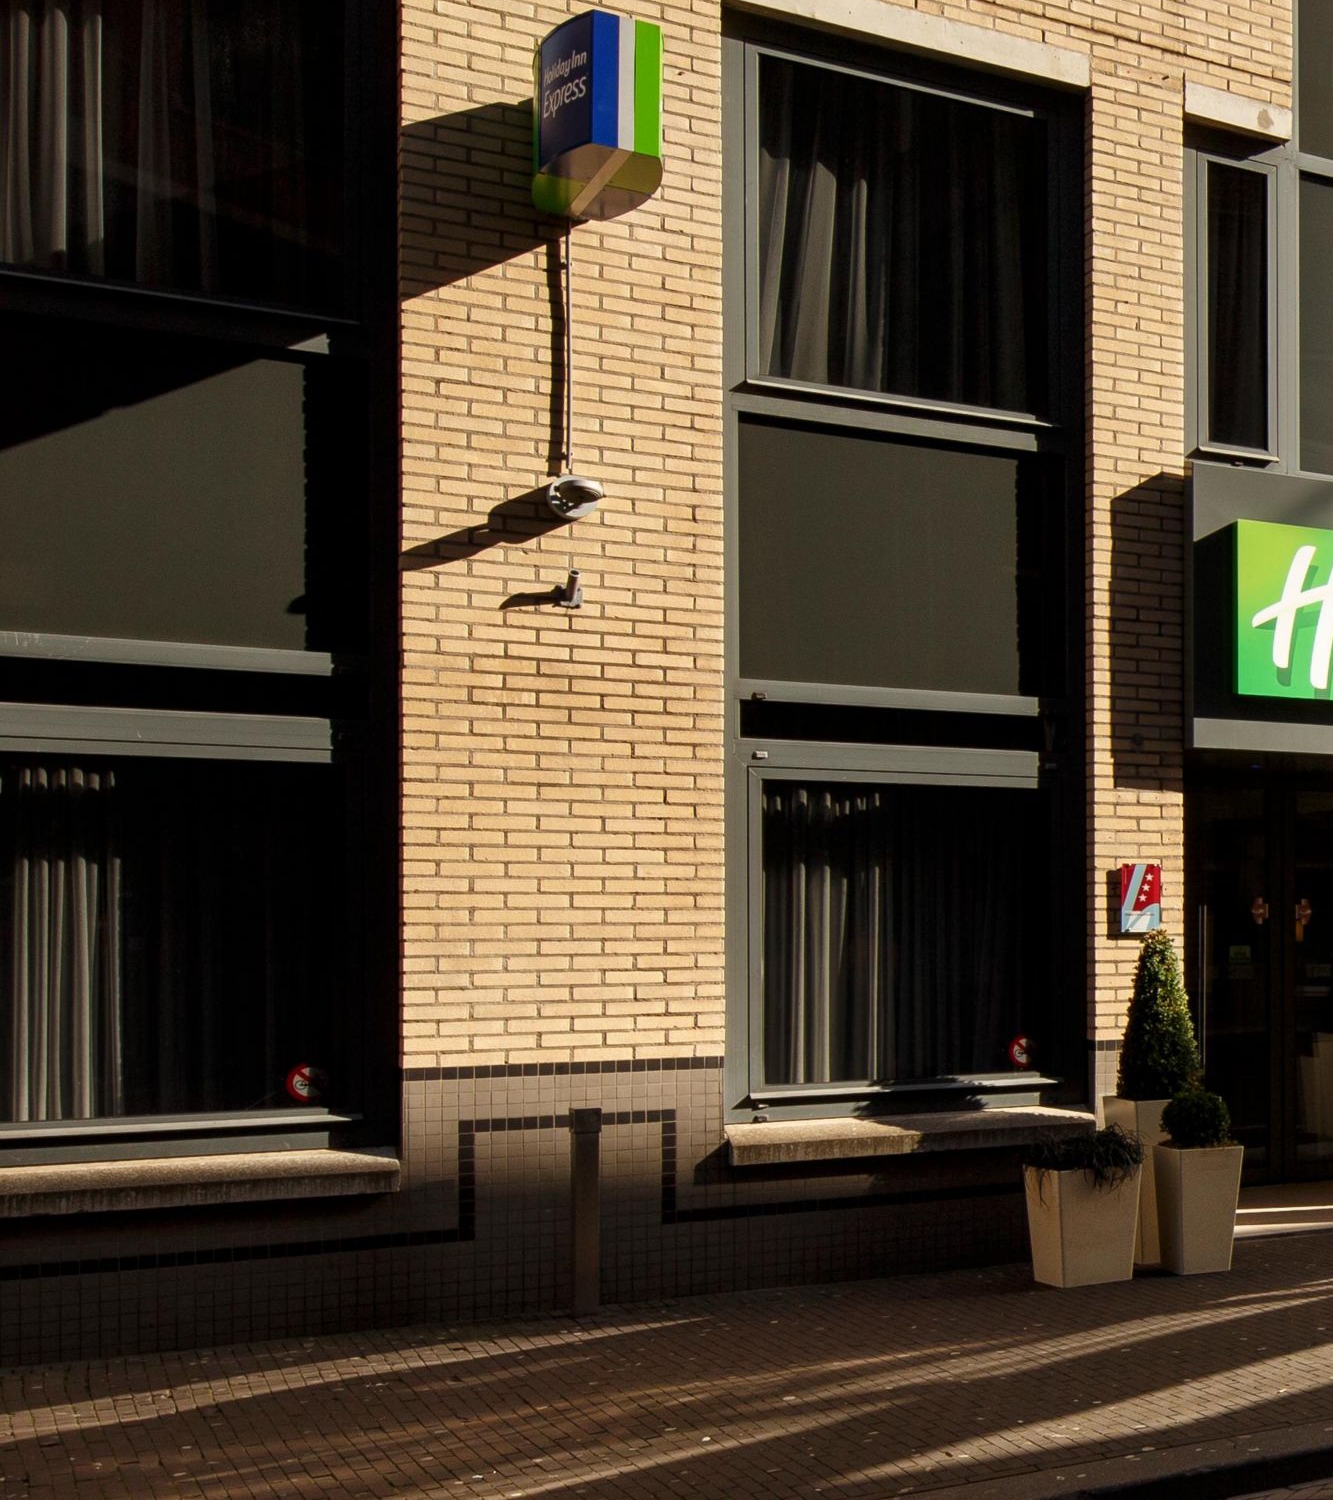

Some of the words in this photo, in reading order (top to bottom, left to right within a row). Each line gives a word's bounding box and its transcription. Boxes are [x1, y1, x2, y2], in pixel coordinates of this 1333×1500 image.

[544, 58, 571, 86] Holiday
[572, 50, 587, 69] Inn
[544, 76, 587, 118] Express
